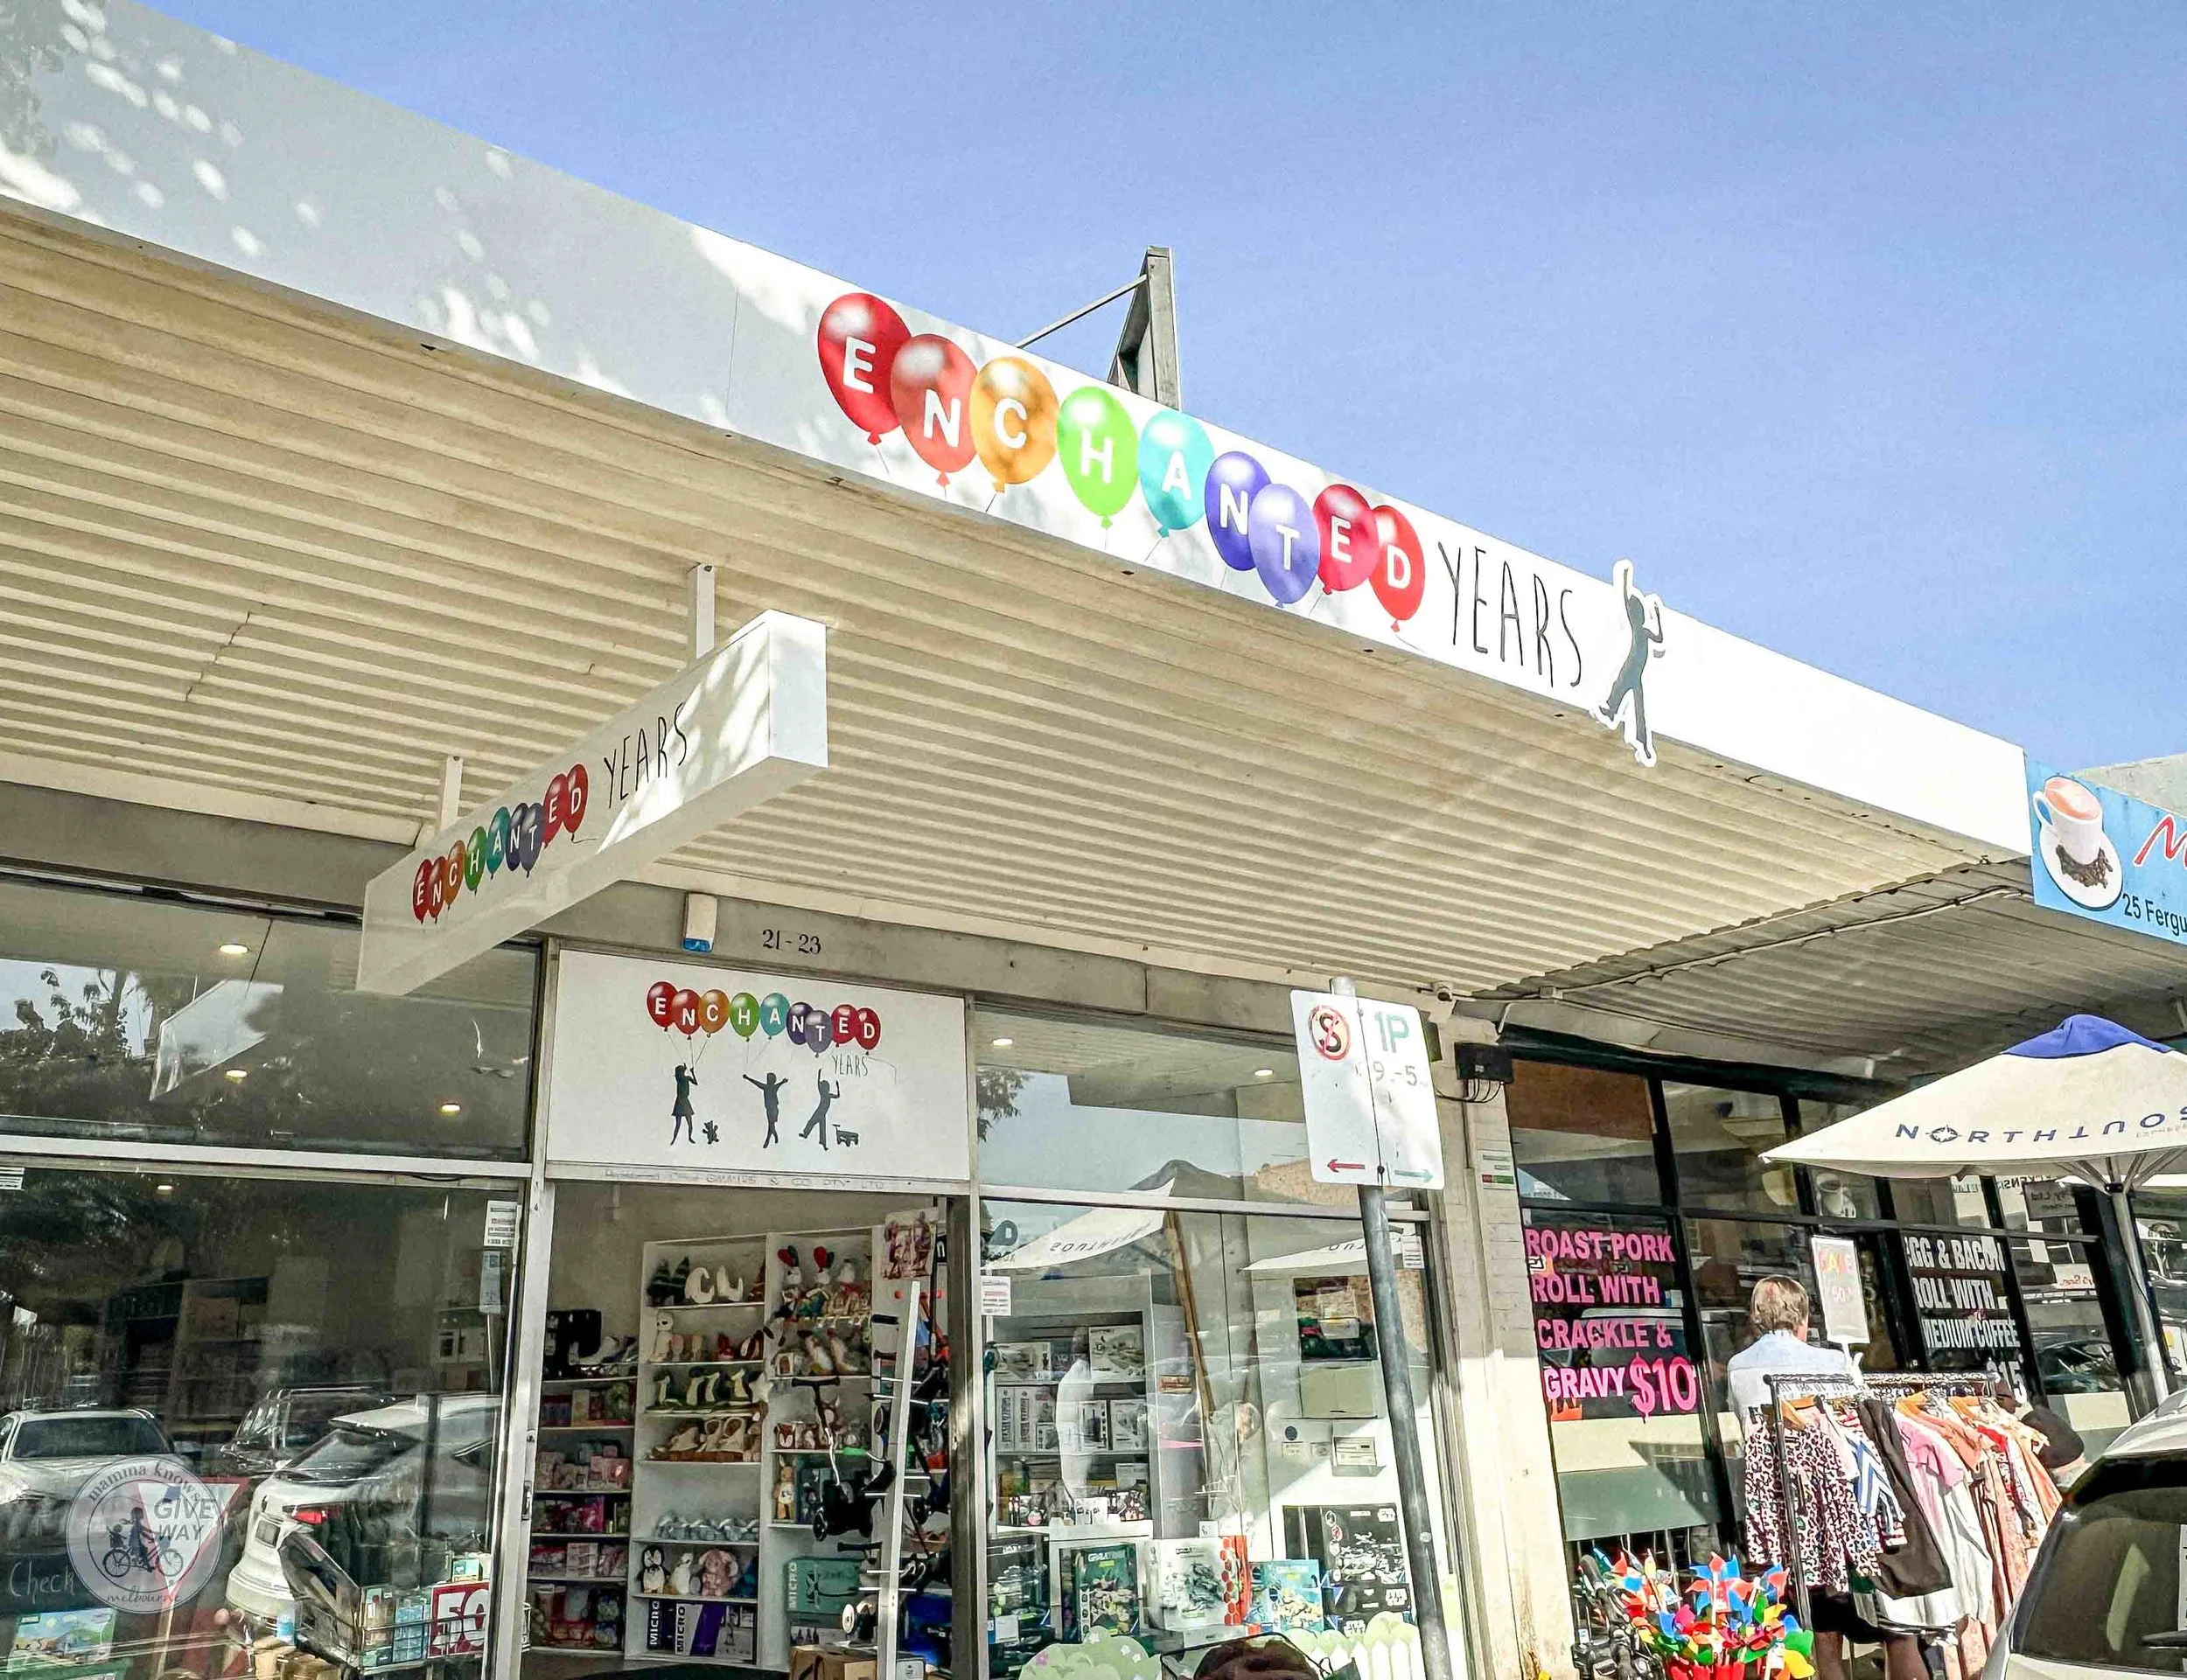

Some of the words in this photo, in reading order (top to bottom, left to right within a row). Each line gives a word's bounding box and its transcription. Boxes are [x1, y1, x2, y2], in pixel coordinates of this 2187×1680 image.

[842, 336, 1411, 589] ENCHANTED
[1437, 541, 1583, 688] YEARS
[416, 787, 582, 900] ENCHANTED
[604, 701, 688, 809] YEARS
[2122, 892, 2142, 919] 25
[654, 996, 876, 1042] ENCHANTED
[1374, 1011, 1409, 1053] 1P
[831, 1054, 869, 1078] YEARS
[1524, 1229, 1604, 1260] ROAST
[1611, 1232, 1676, 1263] PORK
[1937, 1239, 1953, 1269] &
[1951, 1239, 2006, 1272] BACON
[1532, 1273, 1596, 1304] ROLL
[1598, 1275, 1660, 1305] WITH
[1950, 1279, 1996, 1310] WITH
[1537, 1318, 1650, 1349] CRACKLE
[1656, 1321, 1673, 1349] &
[1975, 1318, 2021, 1348] COFFEE
[1543, 1366, 1626, 1400] GRAVY
[1628, 1353, 1698, 1419] $10
[153, 1497, 215, 1520] GIVE
[158, 1523, 205, 1542] WAY
[649, 1600, 660, 1646] MICRO
[676, 1607, 686, 1653] MICRO
